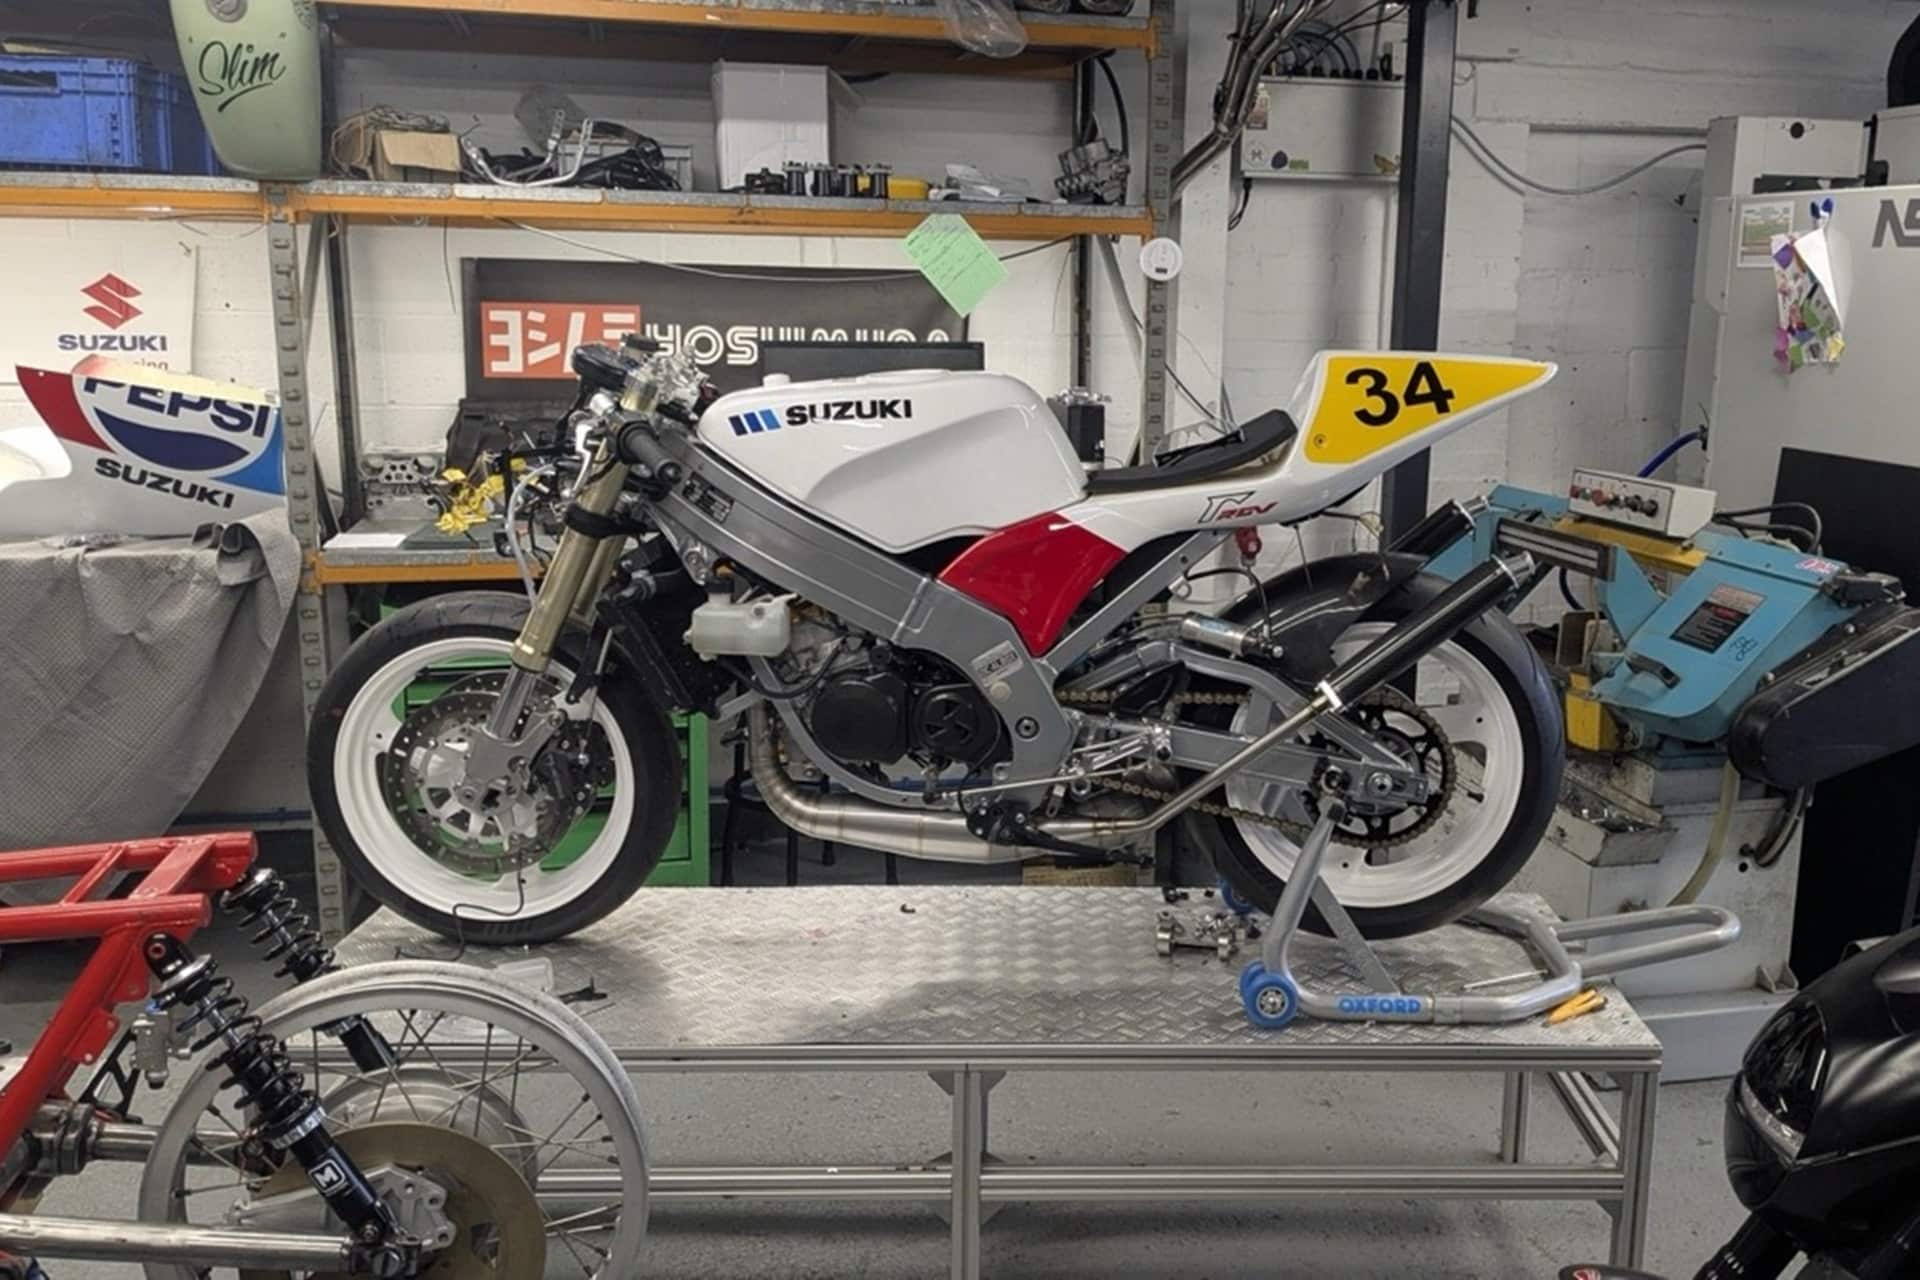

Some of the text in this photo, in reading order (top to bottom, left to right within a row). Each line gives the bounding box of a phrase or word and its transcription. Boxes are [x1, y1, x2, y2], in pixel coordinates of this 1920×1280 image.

[58, 334, 168, 352] SUZUKI
[1345, 361, 1455, 427] 34
[785, 399, 912, 427] SUZUKI
[95, 457, 235, 509] SUZUKI
[1339, 997, 1422, 1014] OXFORD
